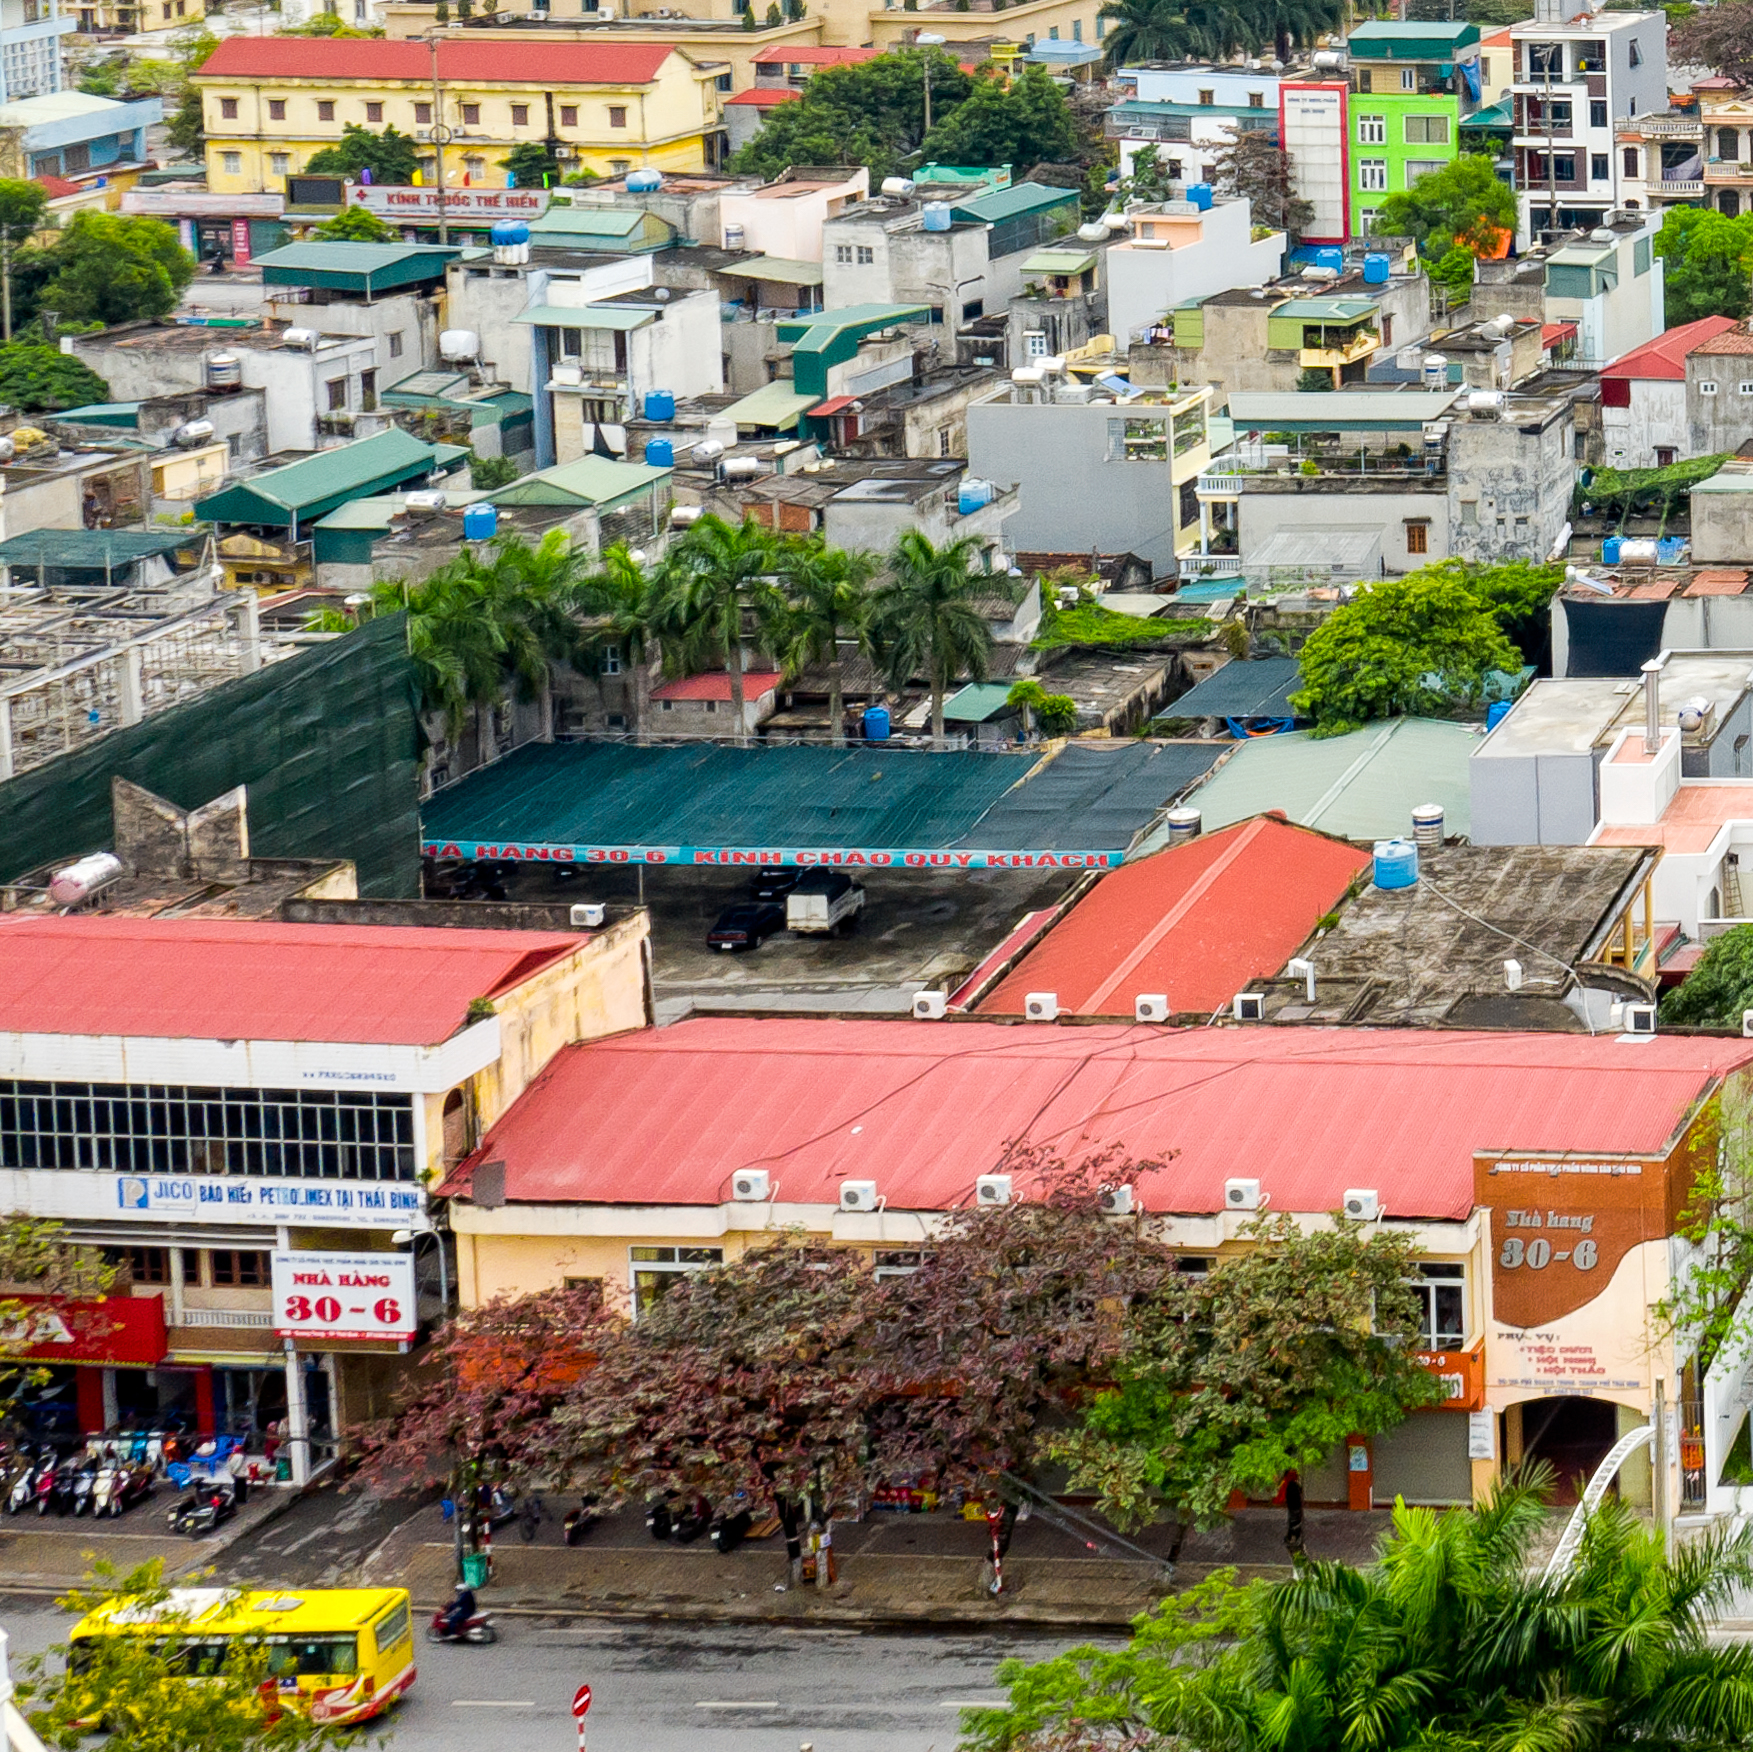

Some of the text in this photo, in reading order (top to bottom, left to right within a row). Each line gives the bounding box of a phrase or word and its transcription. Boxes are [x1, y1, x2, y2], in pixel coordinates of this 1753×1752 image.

[586, 848, 666, 864] 30-6
[987, 850, 1108, 868] KHÁCH
[357, 1186, 386, 1208] THÁI
[1499, 1237, 1598, 1271] 30-6
[292, 1268, 391, 1288] NHÀ HÀNG
